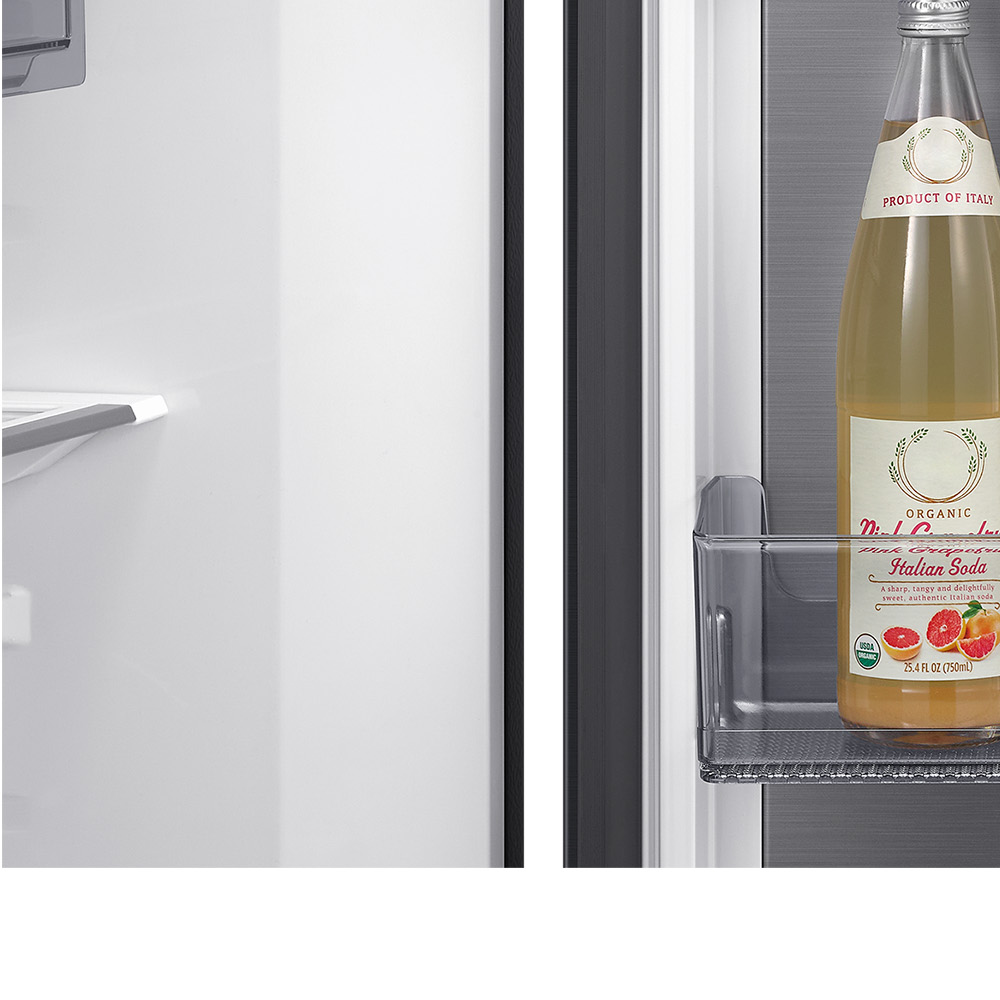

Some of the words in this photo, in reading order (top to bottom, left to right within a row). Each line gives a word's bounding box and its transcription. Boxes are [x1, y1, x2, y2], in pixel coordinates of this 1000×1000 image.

[883, 192, 940, 208] PRODUCT
[945, 192, 961, 203] OF
[966, 193, 994, 206] ITALY
[906, 508, 971, 519] ORGANIC
[888, 557, 945, 577] Italian
[948, 557, 988, 577] Soda
[887, 585, 911, 594] sharp,
[912, 586, 934, 595] tangy
[953, 584, 995, 594] delightfully
[859, 641, 875, 651] USDA
[857, 652, 877, 661] ORGANIC
[903, 662, 919, 673] 25.4
[921, 663, 930, 673] FL
[931, 663, 941, 673] OZ
[942, 661, 973, 674] (750mL)
